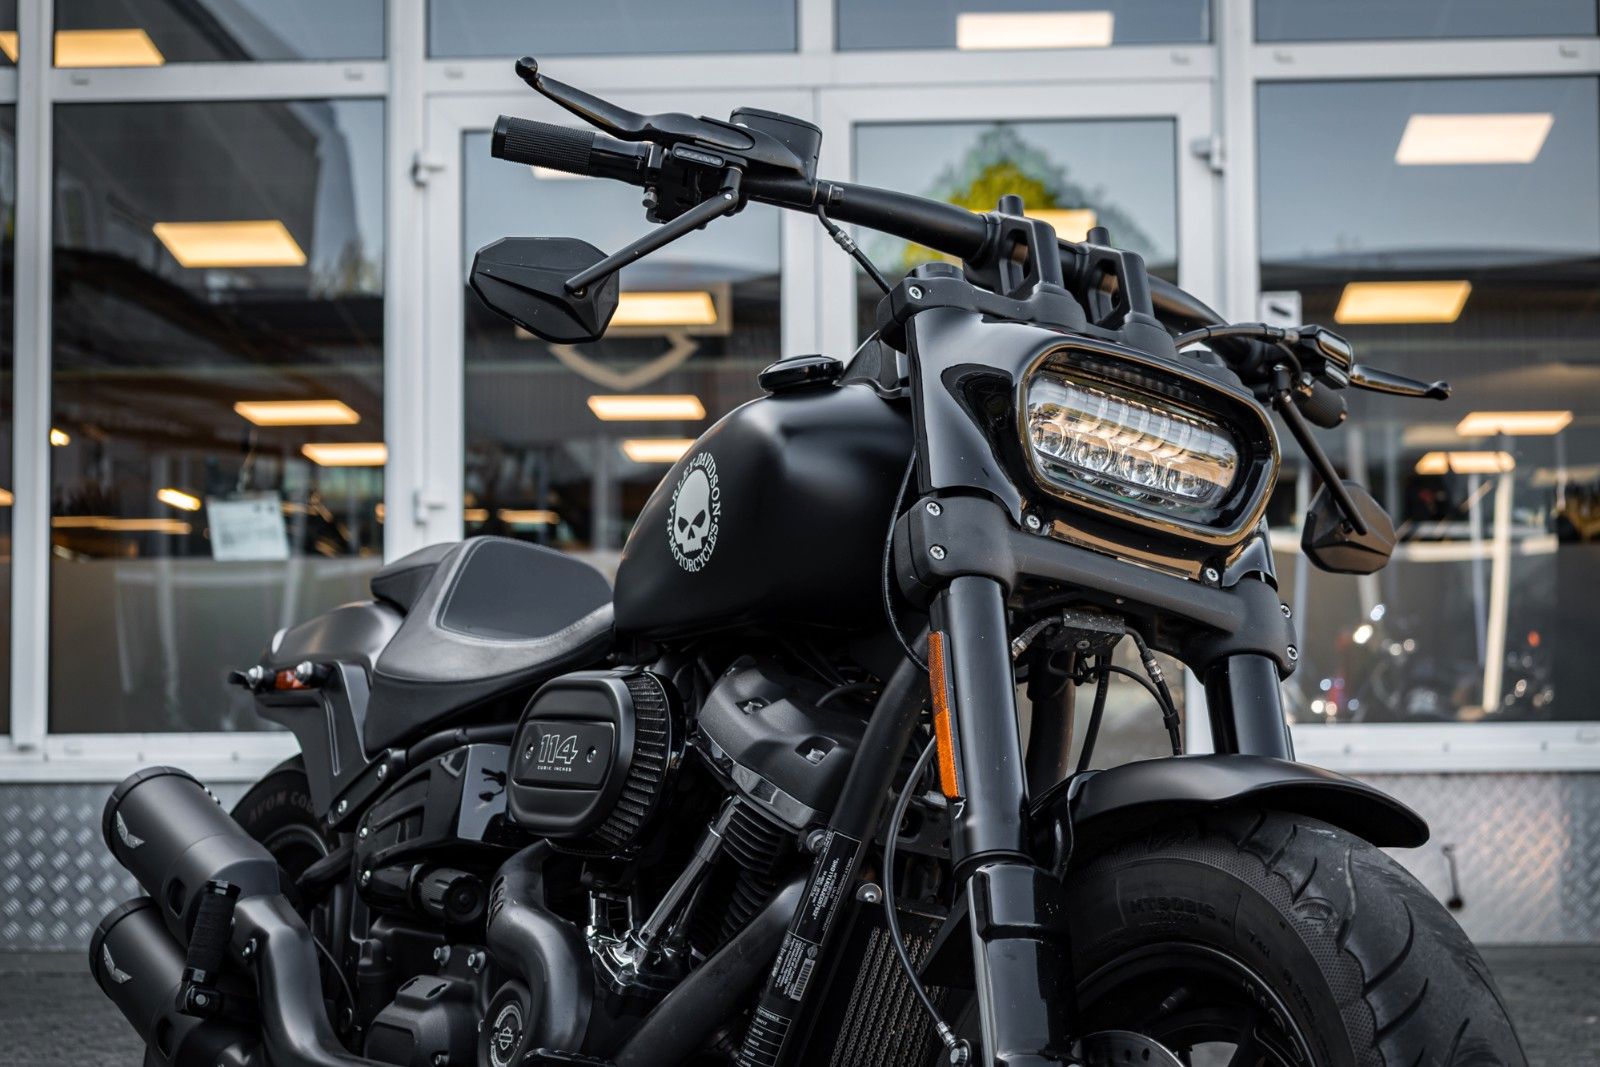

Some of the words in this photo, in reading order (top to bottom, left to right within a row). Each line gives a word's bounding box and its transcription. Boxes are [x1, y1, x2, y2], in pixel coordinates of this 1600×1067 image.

[667, 452, 721, 533] HARLEY-DAVIDSON
[668, 524, 719, 572] MOTORCYCLES
[538, 734, 579, 764] 114
[248, 790, 287, 824] AVON
